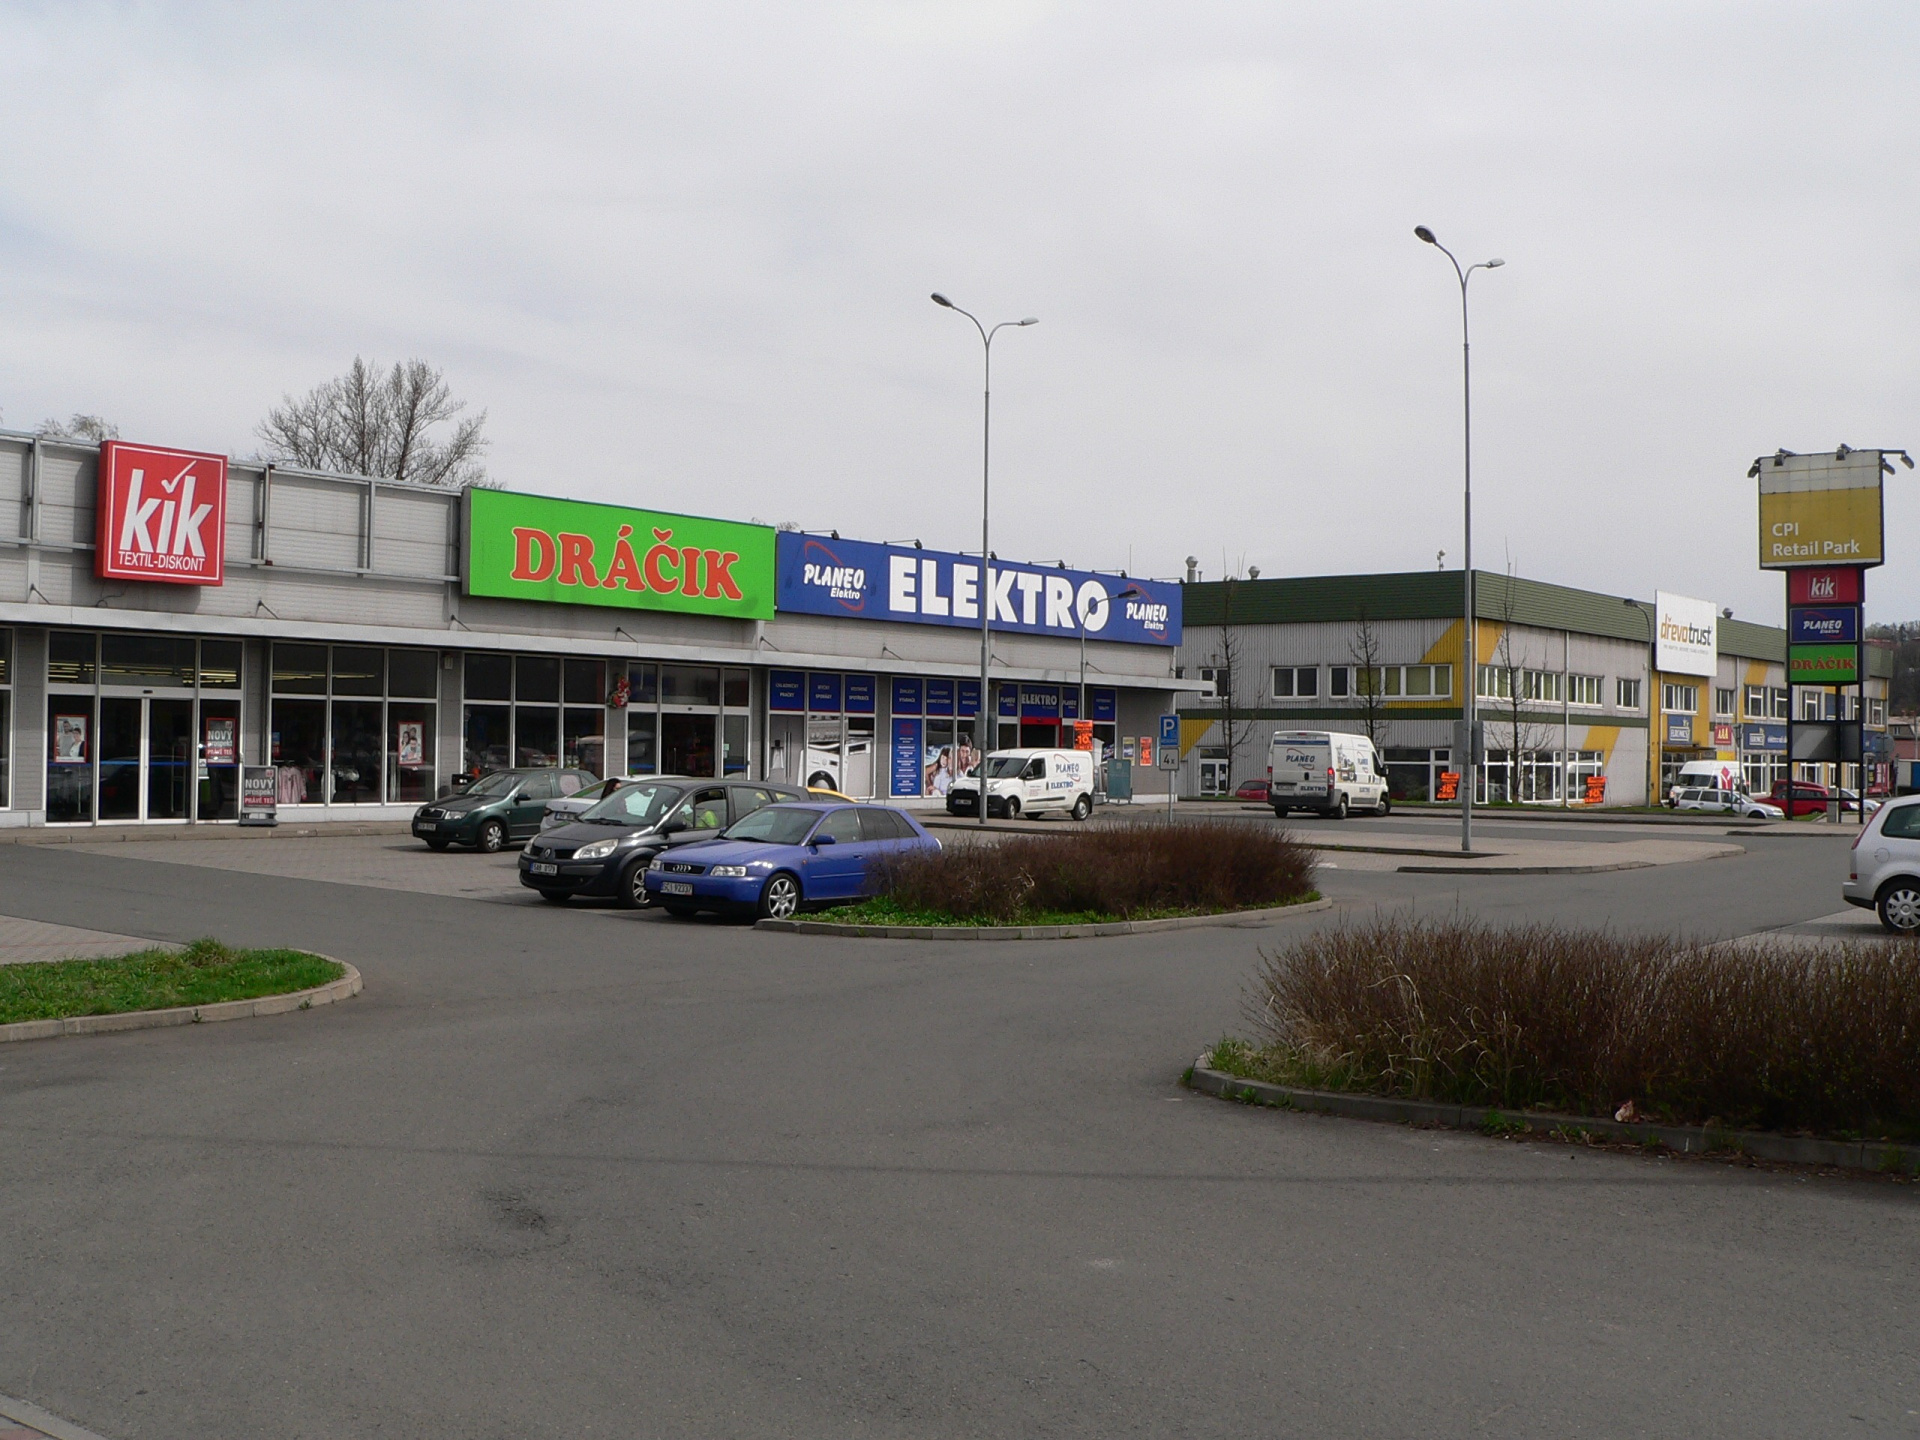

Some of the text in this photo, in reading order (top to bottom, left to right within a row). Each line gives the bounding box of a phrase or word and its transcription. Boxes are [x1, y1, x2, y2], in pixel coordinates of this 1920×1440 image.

[1772, 523, 1799, 537] CPI
[1772, 539, 1860, 556] Retail Park
[118, 551, 205, 571] TEXTIL-DISKONT
[510, 524, 743, 600] DRÁČIK
[803, 563, 866, 590] PLANEO
[1810, 575, 1836, 596] kik
[830, 587, 860, 600] Elektro
[888, 555, 1109, 632] ELEKTRO
[1126, 602, 1168, 622] PLANEO
[1143, 620, 1164, 631] Elektro
[1803, 620, 1843, 630] PLANEO
[1791, 656, 1855, 670] DRÁČIK
[1020, 693, 1058, 706] ELEKTRO
[207, 728, 233, 740] NOVÝ
[1163, 718, 1175, 737] P
[1055, 763, 1080, 773] PLANEO
[244, 777, 274, 789] NOVÝ
[1051, 781, 1074, 789] ELEKTRO
[244, 788, 274, 796] prospekt
